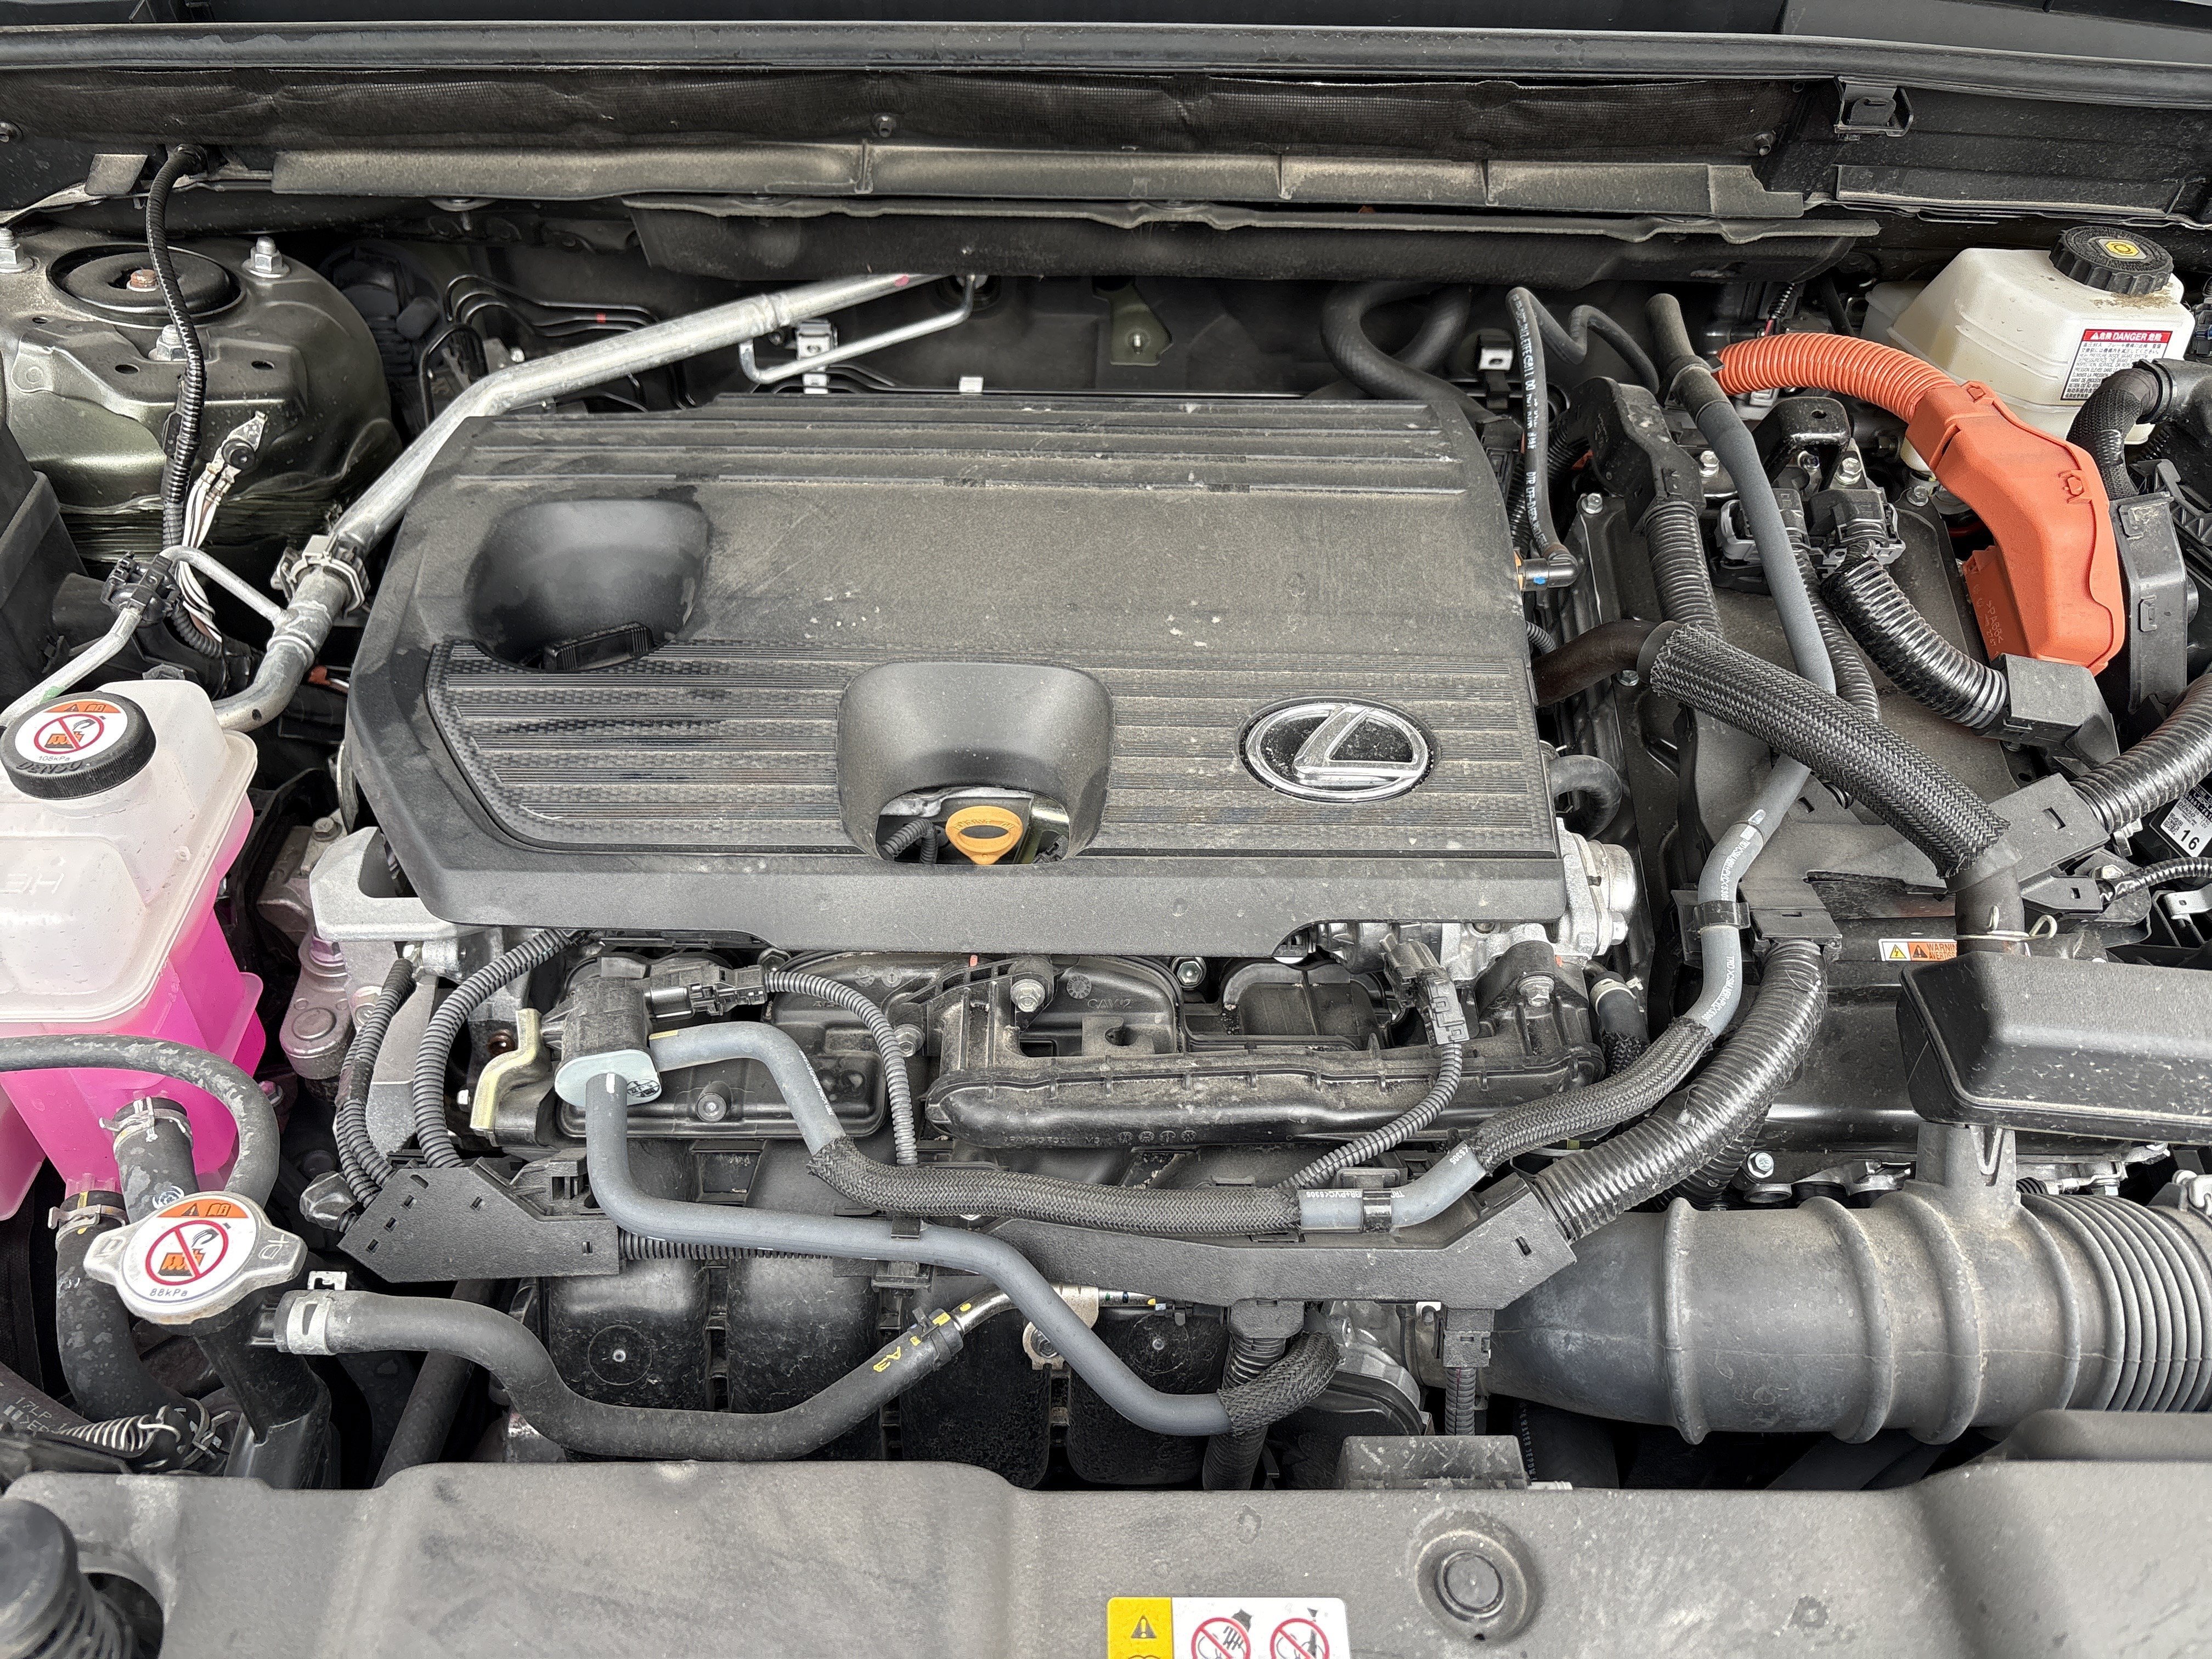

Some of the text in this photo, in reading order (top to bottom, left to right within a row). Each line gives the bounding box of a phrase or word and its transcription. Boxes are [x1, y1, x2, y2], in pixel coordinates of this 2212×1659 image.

[2113, 332, 2147, 341] DANGER
[2178, 802, 2196, 818] DENSO
[2181, 829, 2200, 850] 16
[1926, 943, 1957, 952] WARNIN
[1929, 951, 1956, 960] AVERTISS
[149, 1287, 188, 1297] 88kPa
[15, 1397, 53, 1419] 17LP
